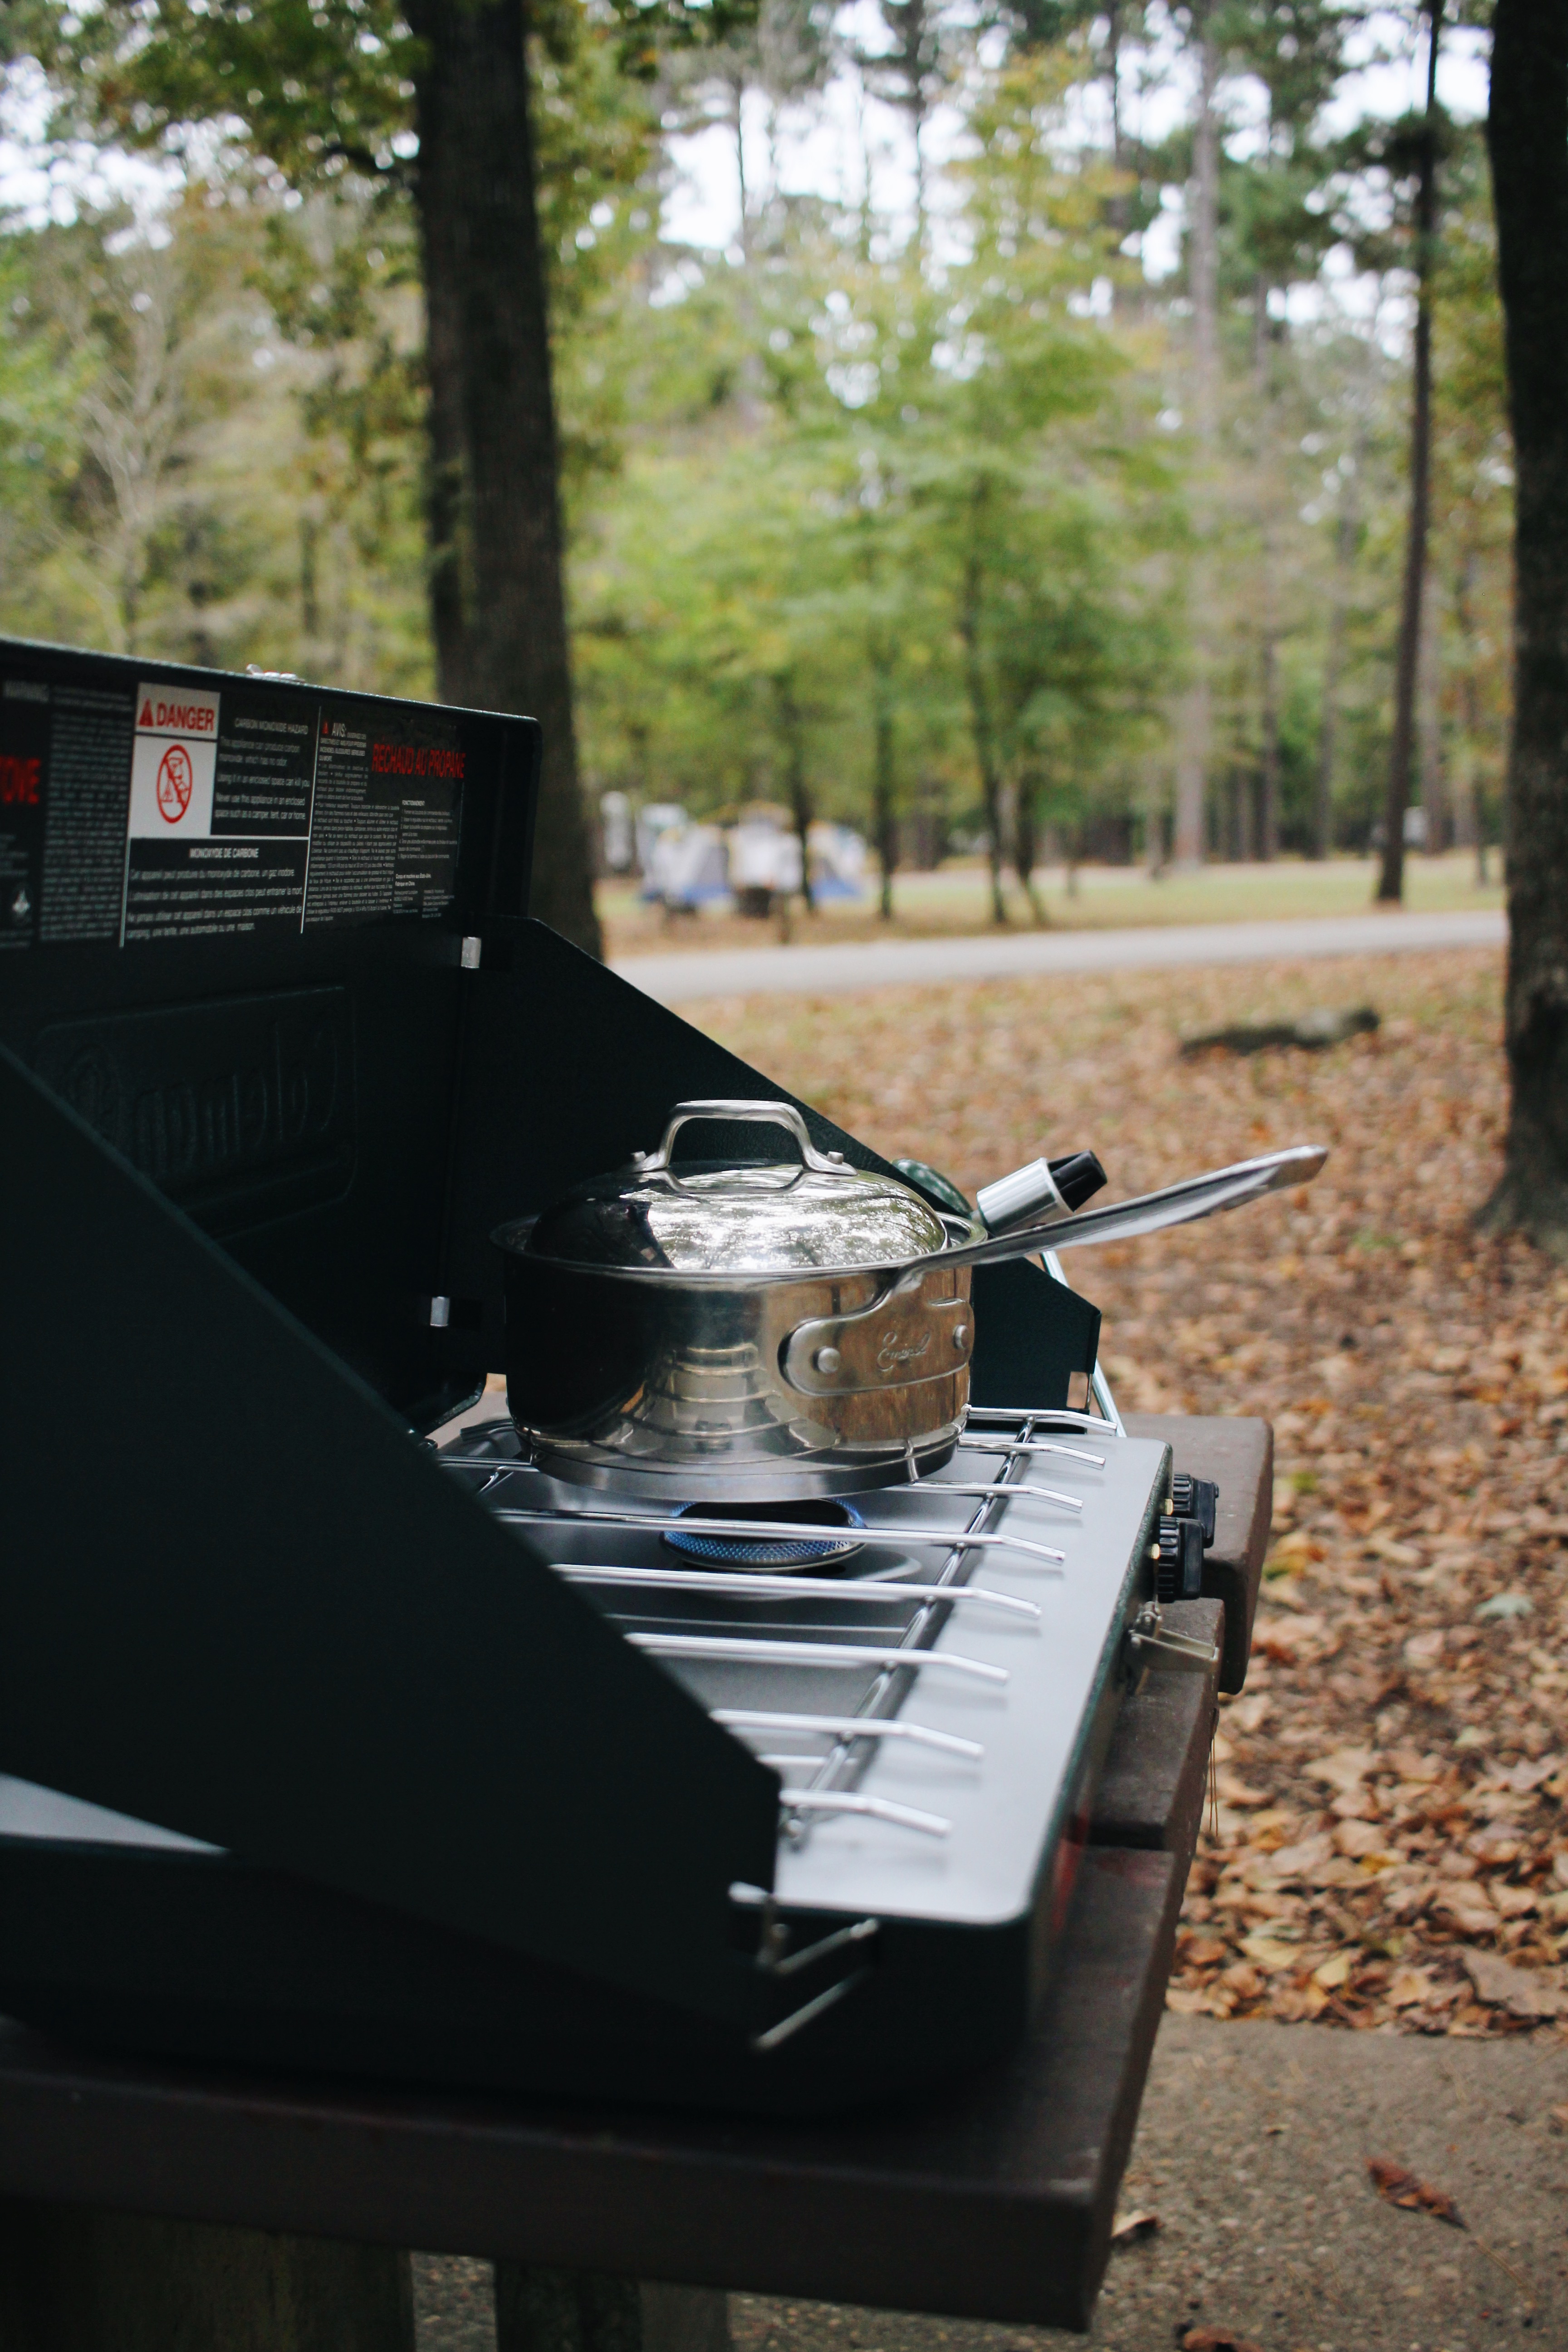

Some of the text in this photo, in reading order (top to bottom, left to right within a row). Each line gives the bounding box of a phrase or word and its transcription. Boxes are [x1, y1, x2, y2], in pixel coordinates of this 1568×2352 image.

[157, 702, 215, 732] DANGER
[288, 724, 308, 734] HAZARD
[371, 736, 466, 778] RÉCHAUD AU PROPANE
[223, 848, 231, 858] DE
[232, 848, 259, 858] CARBONE
[877, 1331, 931, 1372] Emeril
